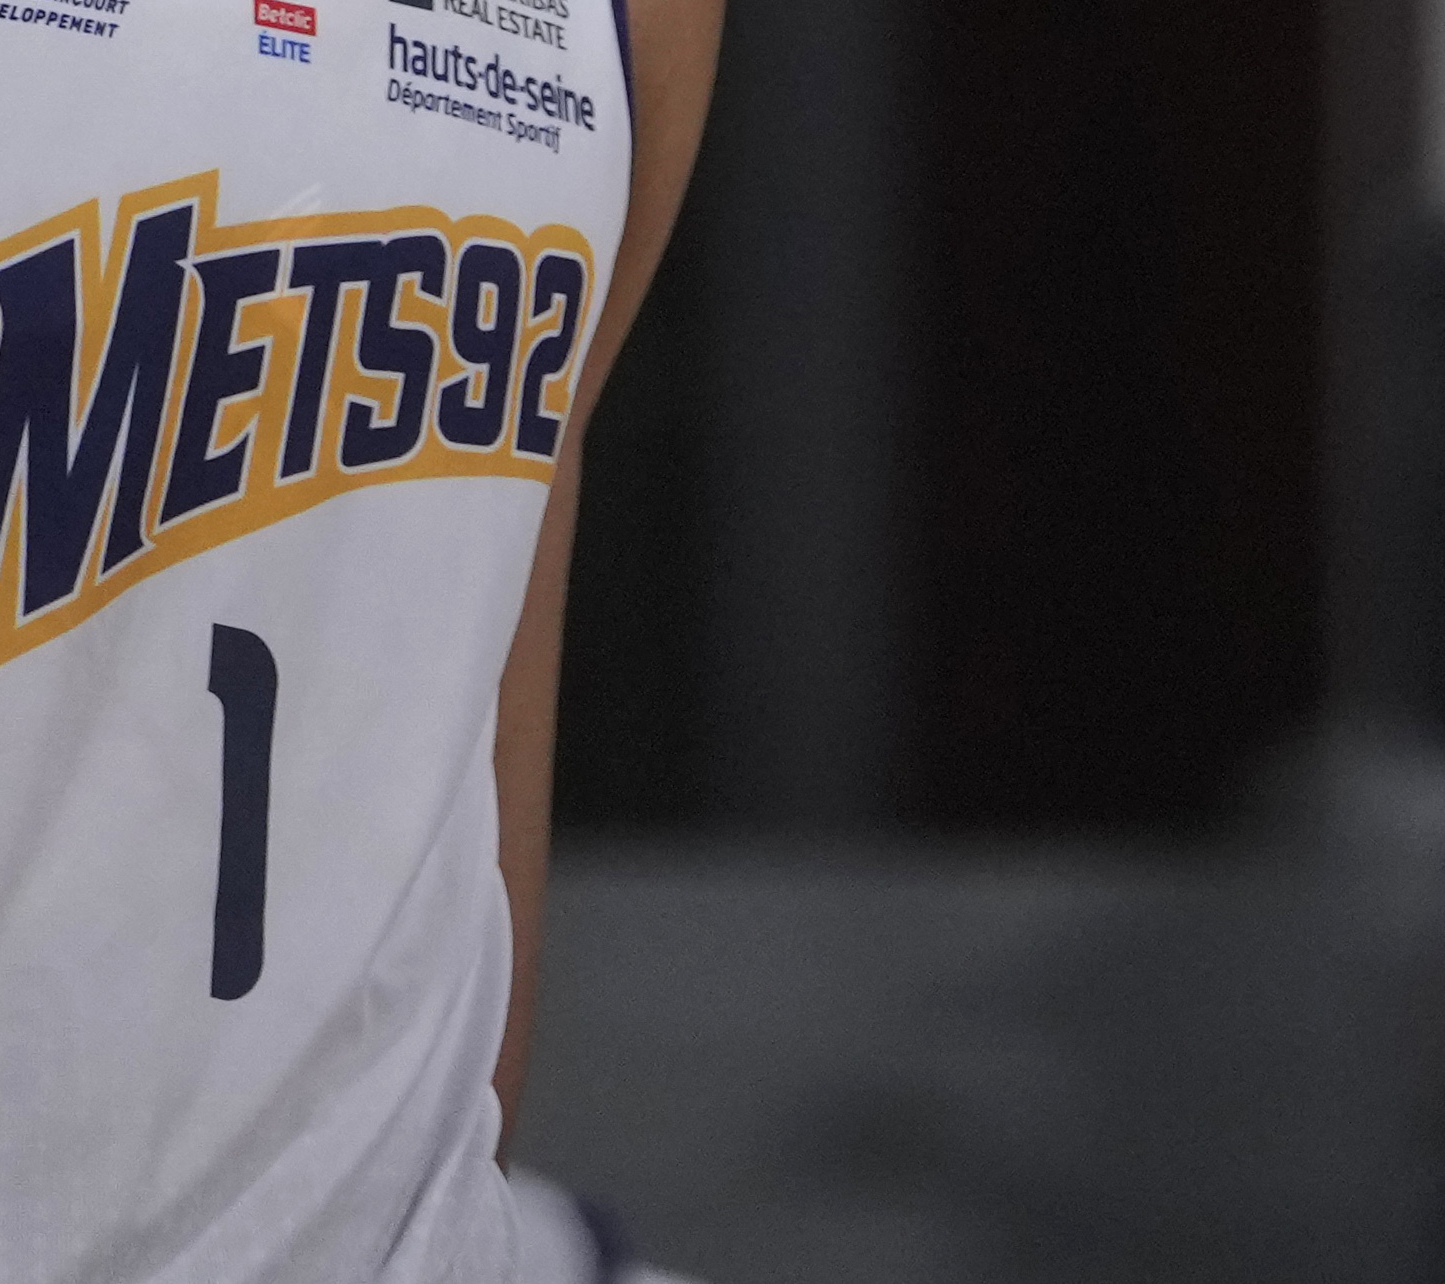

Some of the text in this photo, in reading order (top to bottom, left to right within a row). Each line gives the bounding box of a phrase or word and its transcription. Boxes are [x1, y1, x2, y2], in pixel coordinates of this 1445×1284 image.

[257, 3, 313, 31] Betclic
[499, 5, 567, 51] ESTATE
[258, 30, 312, 64] ÉLITE
[387, 78, 562, 154] Département Sportif
[207, 622, 279, 1002] 1
